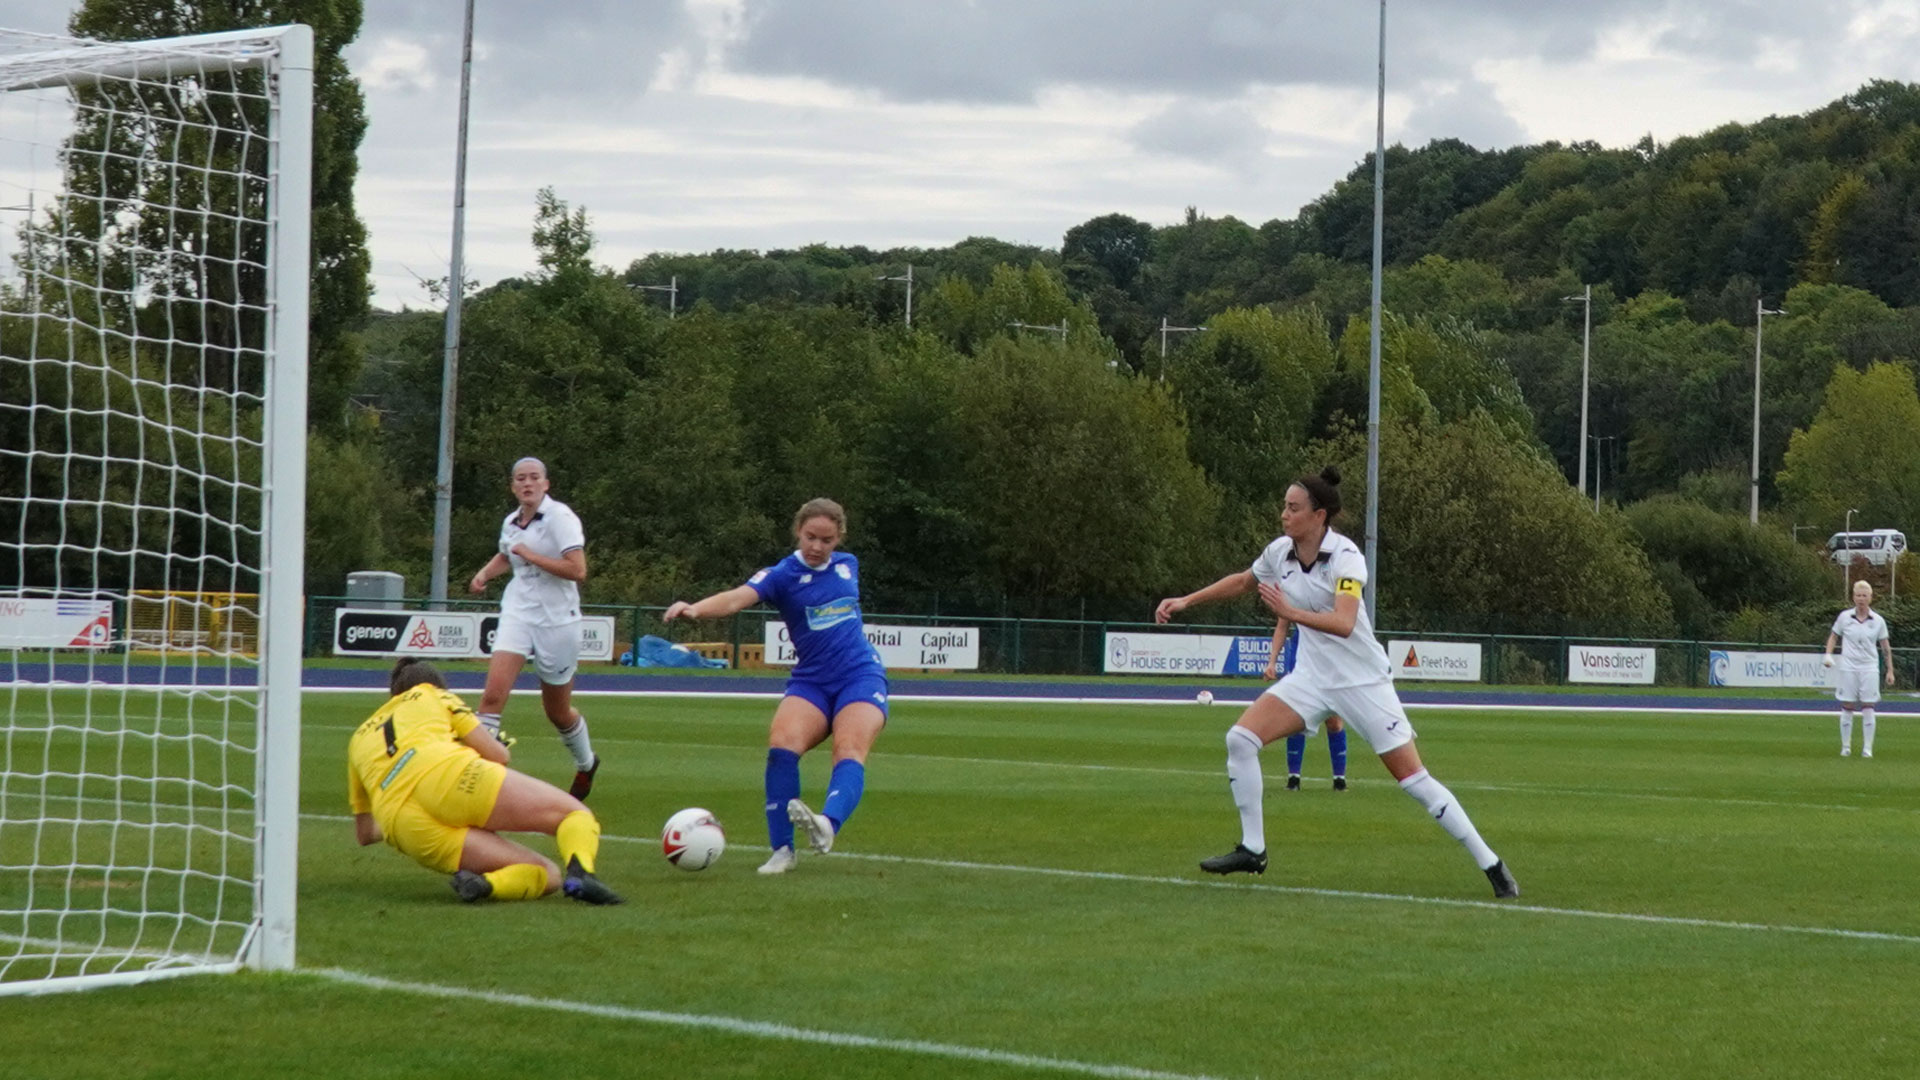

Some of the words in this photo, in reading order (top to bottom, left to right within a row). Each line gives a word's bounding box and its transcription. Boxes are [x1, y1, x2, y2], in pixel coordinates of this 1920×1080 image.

[1339, 578, 1353, 591] C
[346, 626, 398, 644] genero
[438, 626, 464, 637] ADRAN
[582, 629, 598, 640] RAN
[866, 629, 902, 647] pital
[438, 637, 470, 649] PREMIER
[581, 640, 603, 652] EMIER
[921, 630, 968, 651] Capital
[778, 646, 797, 662] La
[921, 651, 949, 666] Law
[1580, 651, 1645, 669] Vansdirect
[1131, 657, 1168, 671] HOUSE
[1170, 658, 1183, 671] OF
[1186, 658, 1217, 672] SPORT
[1238, 661, 1256, 673] FOR
[1257, 661, 1285, 674] WES
[1421, 655, 1443, 668] Fleet
[1444, 656, 1468, 669] Packs
[1745, 662, 1826, 679] WELSHDIVING
